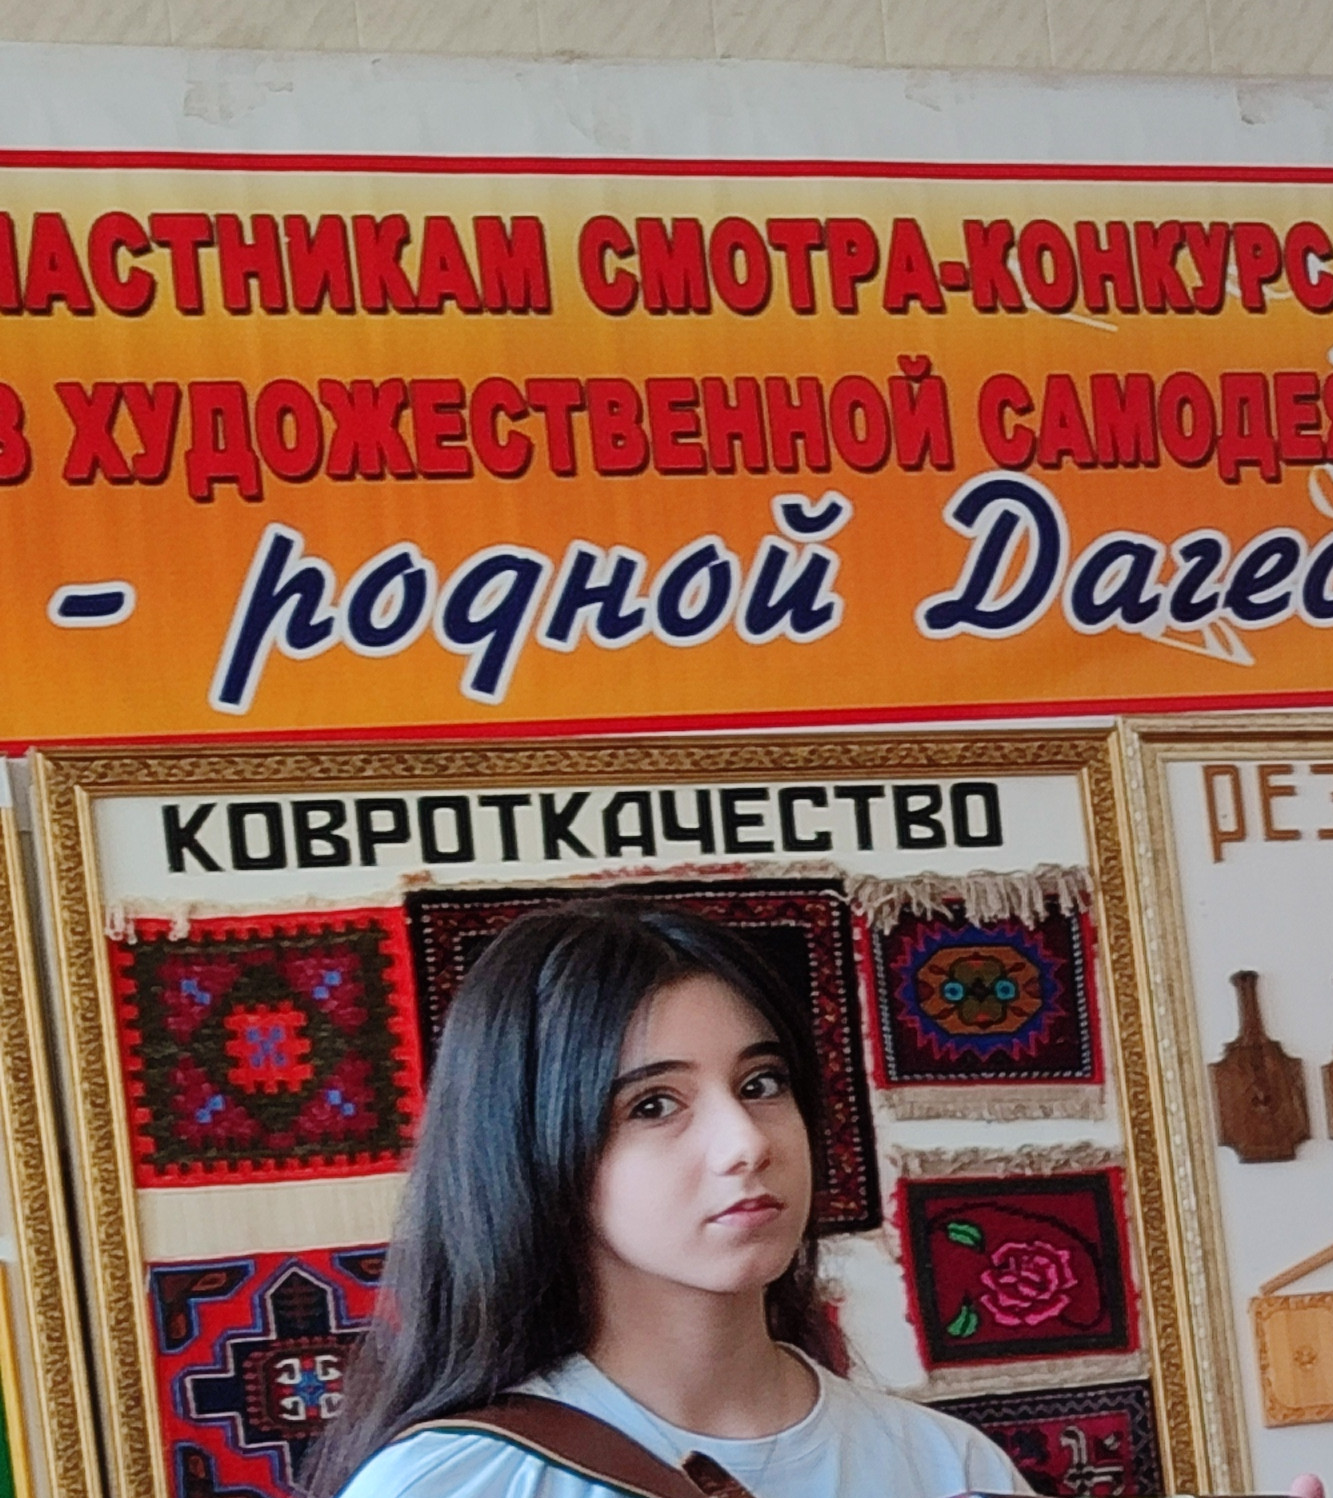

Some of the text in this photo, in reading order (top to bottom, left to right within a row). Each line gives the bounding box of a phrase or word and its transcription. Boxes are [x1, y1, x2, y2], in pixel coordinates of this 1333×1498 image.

[54, 354, 956, 503] ХУДОЖЕСТВЕННОЙ
[218, 500, 845, 706] родной
[162, 783, 1004, 872] КОВРОТКАЧЕСТВО
